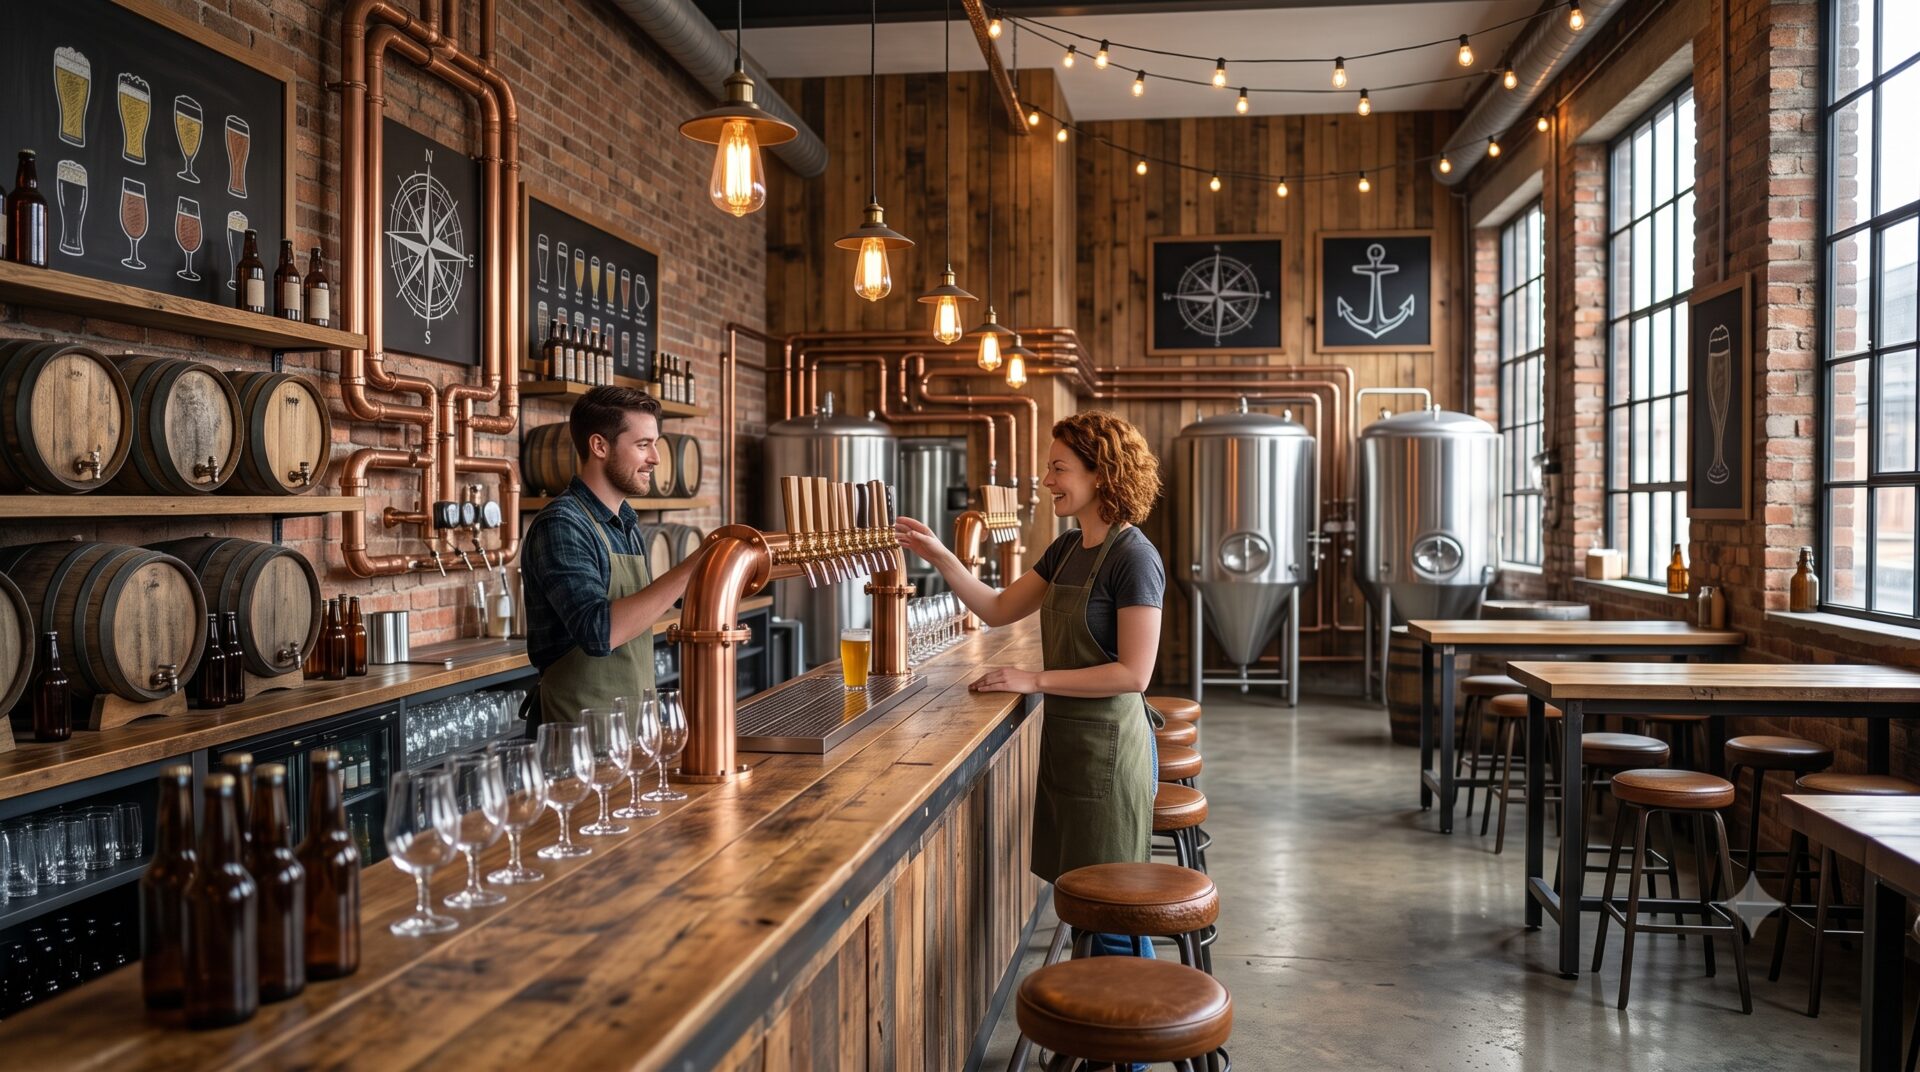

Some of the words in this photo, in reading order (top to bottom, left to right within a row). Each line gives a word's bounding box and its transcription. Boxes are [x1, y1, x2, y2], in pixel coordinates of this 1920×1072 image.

[425, 149, 433, 164] N
[468, 254, 474, 268] E
[425, 330, 431, 345] S
